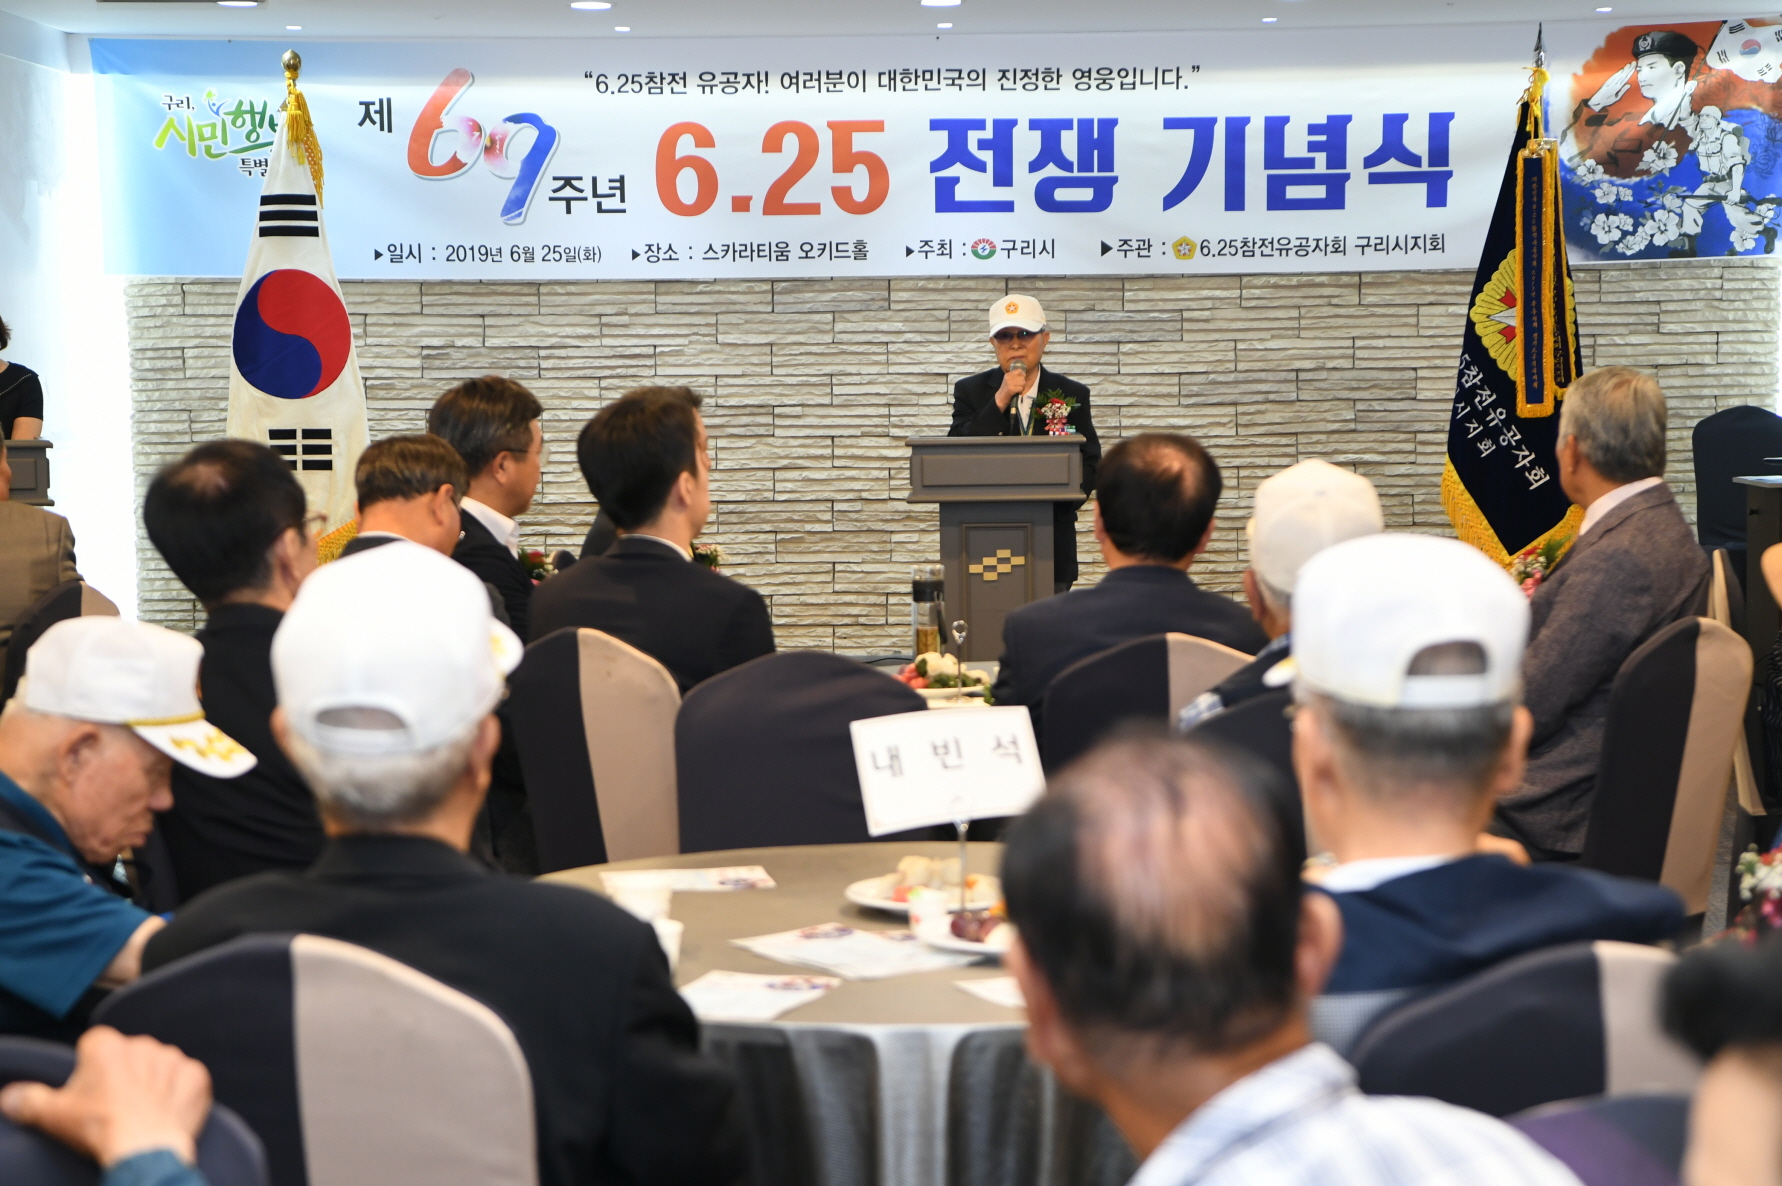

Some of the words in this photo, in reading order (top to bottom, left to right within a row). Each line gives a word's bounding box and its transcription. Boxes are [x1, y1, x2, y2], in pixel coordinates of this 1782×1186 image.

[696, 71, 770, 95] 유공자!
[779, 69, 867, 94] 여러분이
[877, 68, 986, 93] 대한민국의
[996, 67, 1063, 92] 진정한
[239, 158, 269, 177] 특별
[655, 120, 890, 217] 6.25
[928, 117, 1119, 214] 전쟁
[1162, 111, 1456, 212] 기념식
[387, 243, 422, 264] 일시
[445, 244, 503, 263] 2019년
[509, 244, 536, 263] 6월
[541, 244, 602, 264] 25일(화)
[643, 242, 680, 263] 장소
[702, 240, 792, 262] 스카라티움
[798, 239, 870, 261] 오키드홀
[917, 238, 953, 260] 주최
[1000, 238, 1056, 260] 구리시
[1116, 237, 1153, 259] 주관
[1199, 235, 1347, 259] 6.25참전유공자회
[1354, 233, 1446, 256] 구리시지회
[1455, 387, 1496, 458] 시지회
